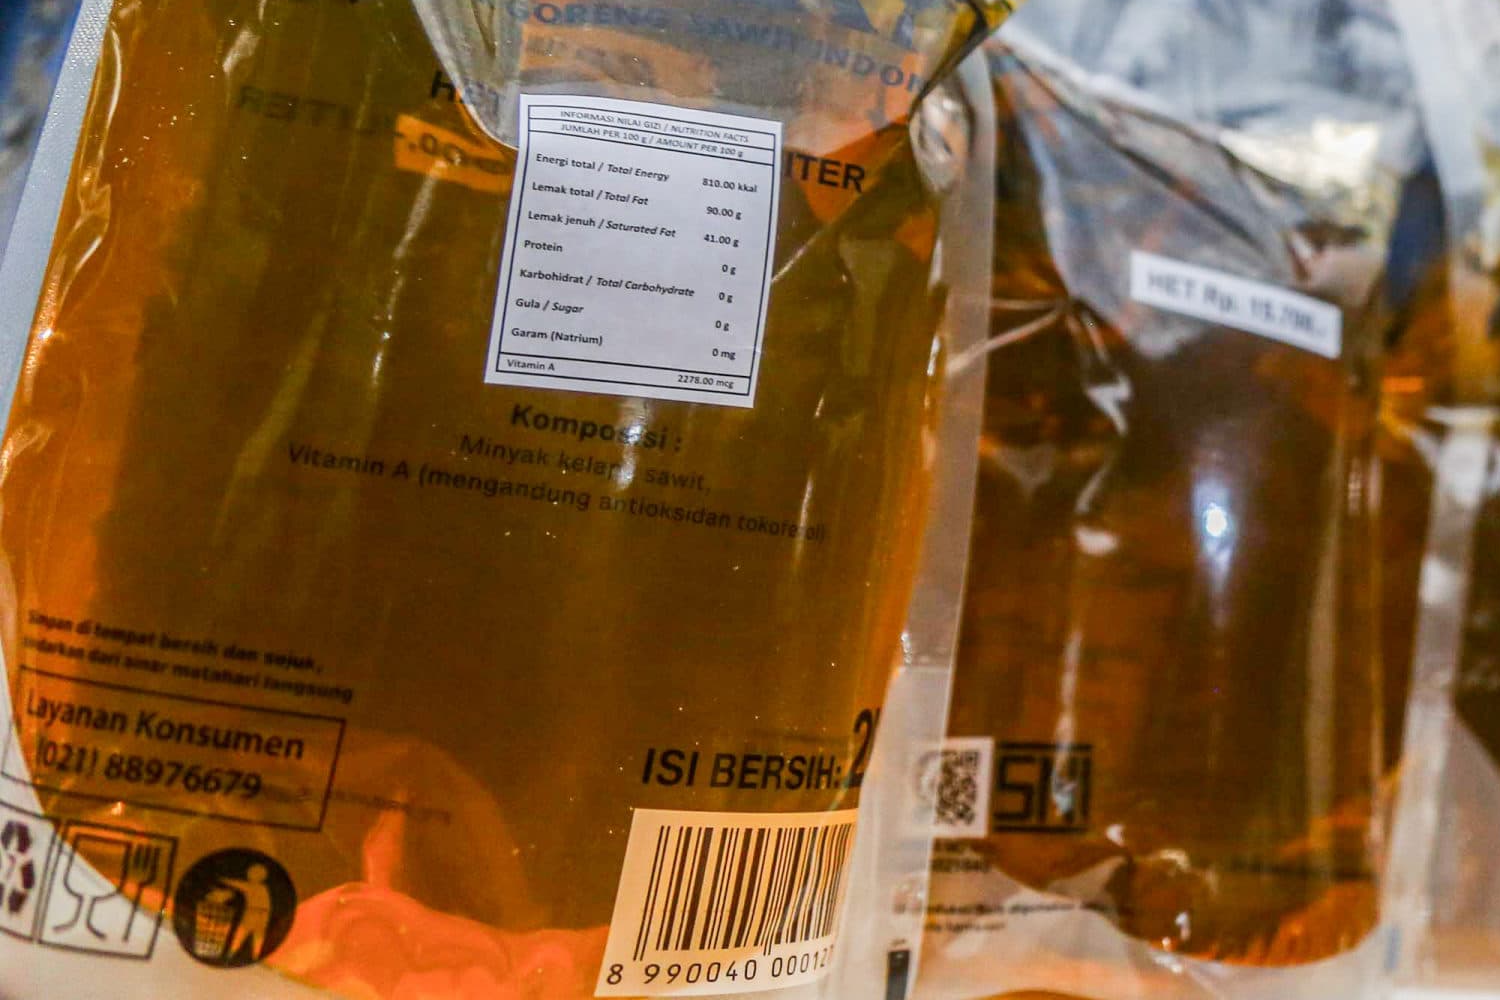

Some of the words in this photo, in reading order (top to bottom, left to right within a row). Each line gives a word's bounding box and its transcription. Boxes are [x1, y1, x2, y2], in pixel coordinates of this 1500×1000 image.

[561, 111, 614, 123] INFORMASI
[617, 117, 641, 127] NILAI
[644, 121, 662, 130] GIZI
[671, 125, 720, 139] NUTRITION
[723, 133, 749, 142] FACTS
[560, 124, 600, 135] JUMLAH
[603, 130, 620, 138] PER
[623, 133, 639, 141] 100
[641, 136, 647, 144] g
[656, 138, 698, 150] AMOUNT
[701, 144, 718, 153] PER
[720, 147, 736, 155] 100
[536, 153, 569, 168] Energi
[568, 157, 596, 170] total
[607, 163, 633, 175] Total
[635, 167, 670, 182] Energy
[785, 151, 865, 193] ITER
[532, 182, 567, 194] Lemak
[569, 185, 594, 198] total
[604, 190, 630, 203] Total
[632, 194, 648, 205] Fat
[702, 177, 735, 190] 810.00
[738, 182, 757, 193] kkal
[528, 210, 563, 223] Lemak
[564, 214, 596, 227] jenuh
[606, 220, 657, 236] Saturated
[660, 226, 676, 238] Fat
[706, 206, 733, 218] 90.00
[735, 210, 741, 221] g
[524, 239, 563, 253] Protein
[704, 234, 731, 246] 41.00
[732, 238, 739, 248] g
[722, 263, 728, 273] 0
[729, 266, 736, 276] g
[520, 268, 584, 285] Karbohidrat
[596, 277, 623, 289] Total
[625, 280, 695, 297] Carbohydrate
[1149, 273, 1195, 298] HET
[516, 297, 540, 310] Gula
[552, 301, 584, 315] Sugar
[719, 292, 725, 301] 0
[726, 294, 733, 304] g
[511, 327, 547, 341] Garam
[550, 330, 603, 346] (Natrium)
[715, 320, 722, 329] 0
[723, 323, 729, 332] g
[506, 359, 545, 371] Vitamin
[547, 362, 555, 371] A
[712, 348, 718, 357] 0
[720, 351, 736, 361] mg
[678, 374, 714, 387] 2278.00
[716, 379, 734, 390] mcg
[461, 435, 549, 465] Minyak
[559, 452, 638, 481] kelap
[645, 469, 711, 496] sawit,
[289, 441, 384, 476] Vitamin
[391, 460, 409, 479] A
[419, 462, 591, 511] (mengandung
[600, 495, 730, 530] antioksidan
[737, 516, 826, 545] tokofeol)
[96, 623, 155, 645] tempat
[161, 633, 217, 654] bersih
[224, 645, 257, 660] dan
[173, 664, 259, 687] matahari
[264, 677, 352, 704] langsung
[26, 690, 127, 732] Layanan
[136, 710, 304, 759] Konsumen
[642, 748, 698, 786] ISI
[710, 753, 841, 790] BERSIH:
[847, 708, 880, 788] 2
[36, 736, 98, 777] (021)
[104, 754, 261, 798] 88976679
[606, 964, 623, 985] 8
[644, 960, 757, 984] 990040
